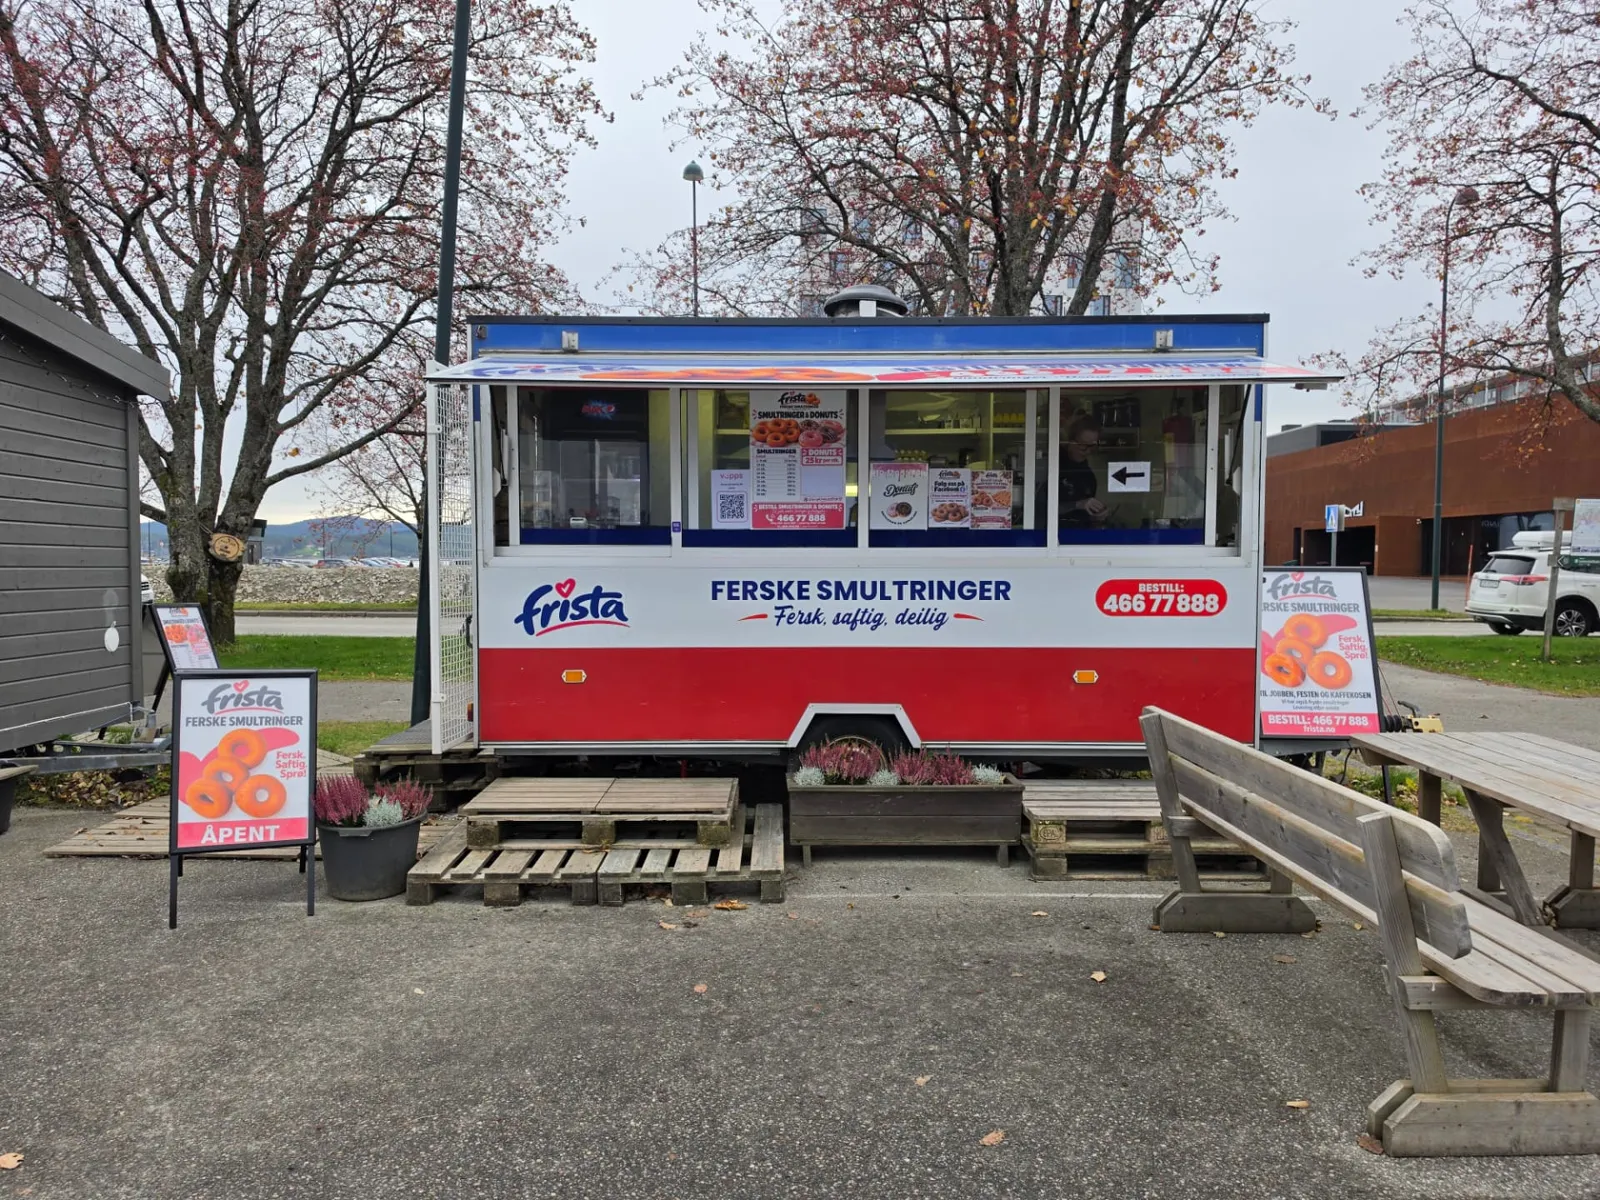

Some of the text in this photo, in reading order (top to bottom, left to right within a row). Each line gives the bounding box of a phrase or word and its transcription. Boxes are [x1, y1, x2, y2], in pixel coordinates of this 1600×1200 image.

[757, 411, 804, 419] SMULTRINGER
[810, 411, 838, 419] DONUTS
[776, 514, 826, 522] 466 77 888
[711, 580, 1012, 601] FERSKE SMULTRINGER
[1138, 583, 1185, 593] BESTILL:
[1266, 572, 1338, 601] frista
[514, 578, 629, 636] frista
[1103, 594, 1220, 613] 466 77 888
[1291, 602, 1360, 613] SMULTRINGER
[895, 608, 949, 631] deilig
[201, 680, 284, 714] frista
[1270, 690, 1296, 698] JOBBEN,
[1331, 691, 1372, 699] KAFFEKOSEN
[185, 716, 304, 727] FERSKE SMULTRINGER
[1268, 714, 1369, 726] BESTILL: 466 77 888
[1303, 725, 1336, 733] frista.no
[276, 750, 306, 760] Fersk.
[280, 770, 307, 780] Sprø!
[200, 823, 280, 844] ÅPENT
